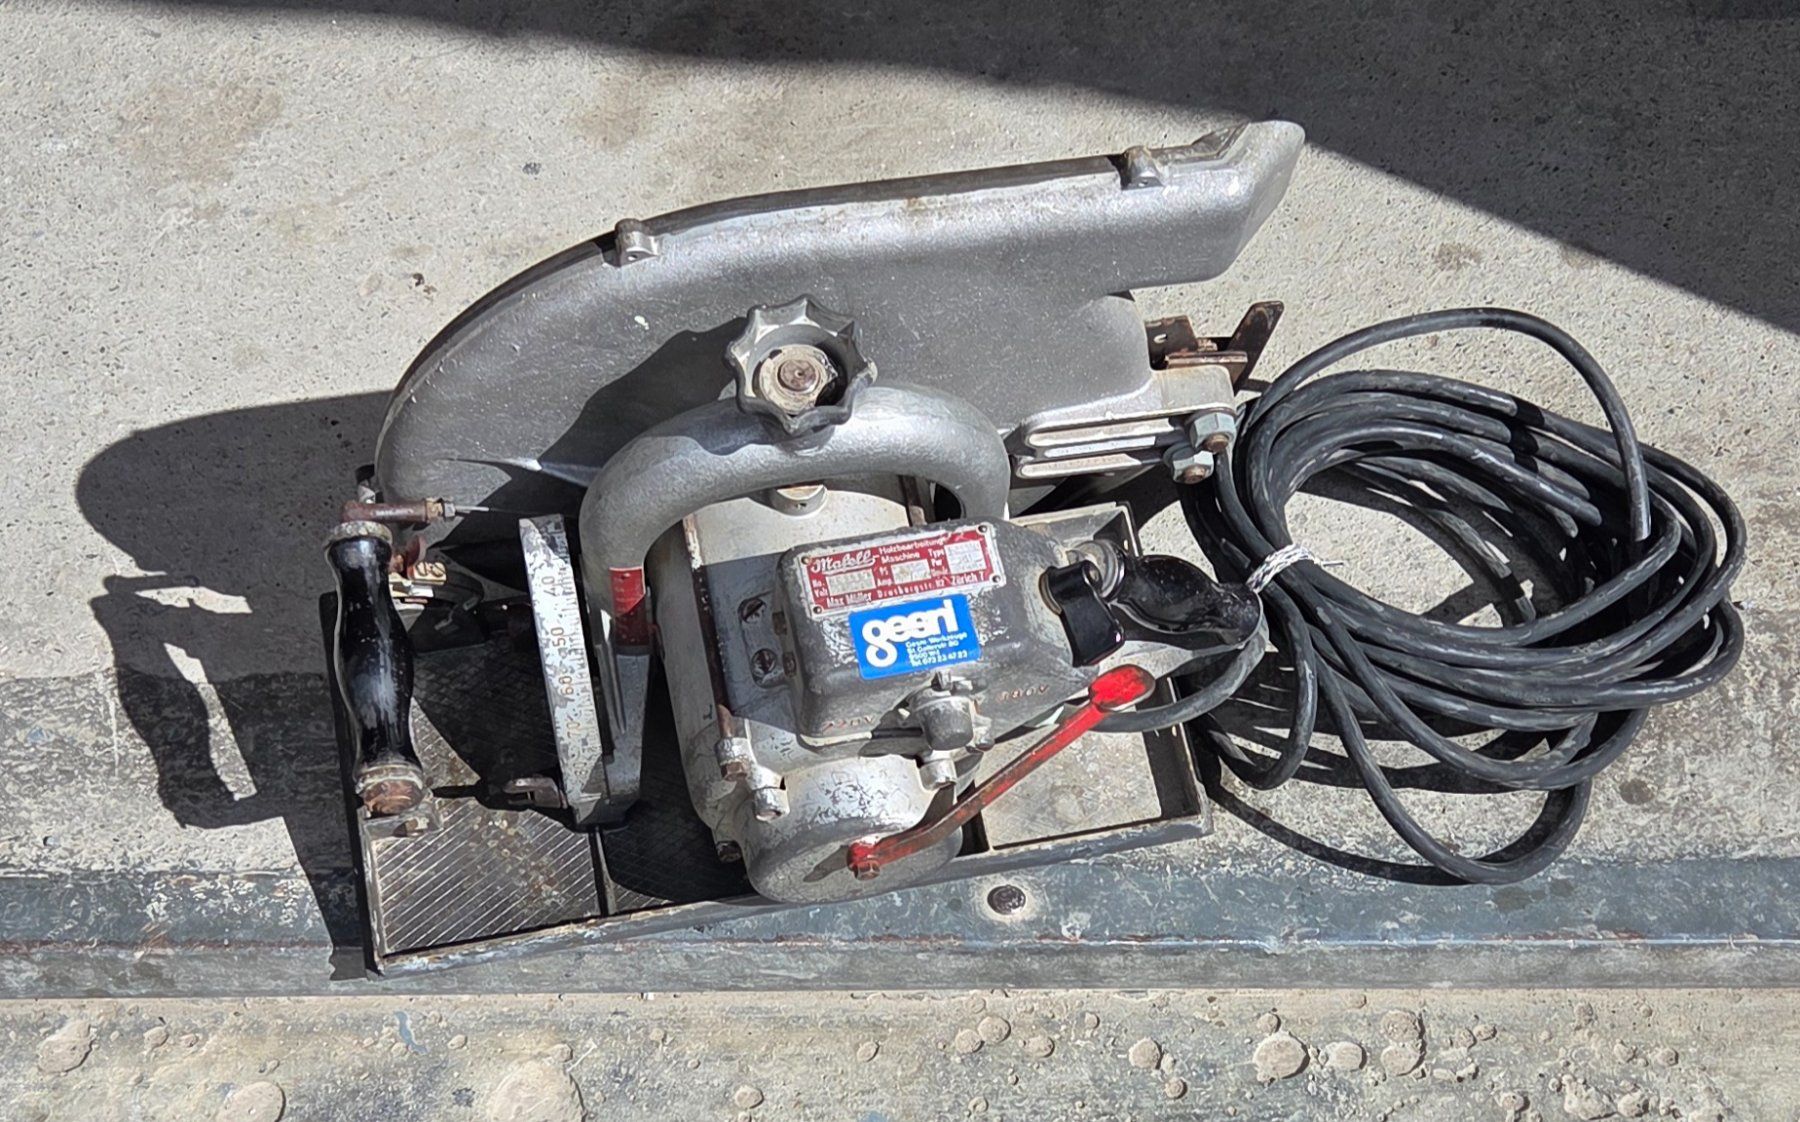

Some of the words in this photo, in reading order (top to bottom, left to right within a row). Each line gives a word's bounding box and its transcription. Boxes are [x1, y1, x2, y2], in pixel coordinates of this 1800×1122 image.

[811, 549, 880, 575] Mafell
[881, 552, 920, 564] Maschine
[827, 597, 845, 608] Max
[950, 572, 978, 586] Zürich
[551, 627, 566, 647] 50
[558, 676, 574, 696] 60
[567, 722, 581, 738] 70
